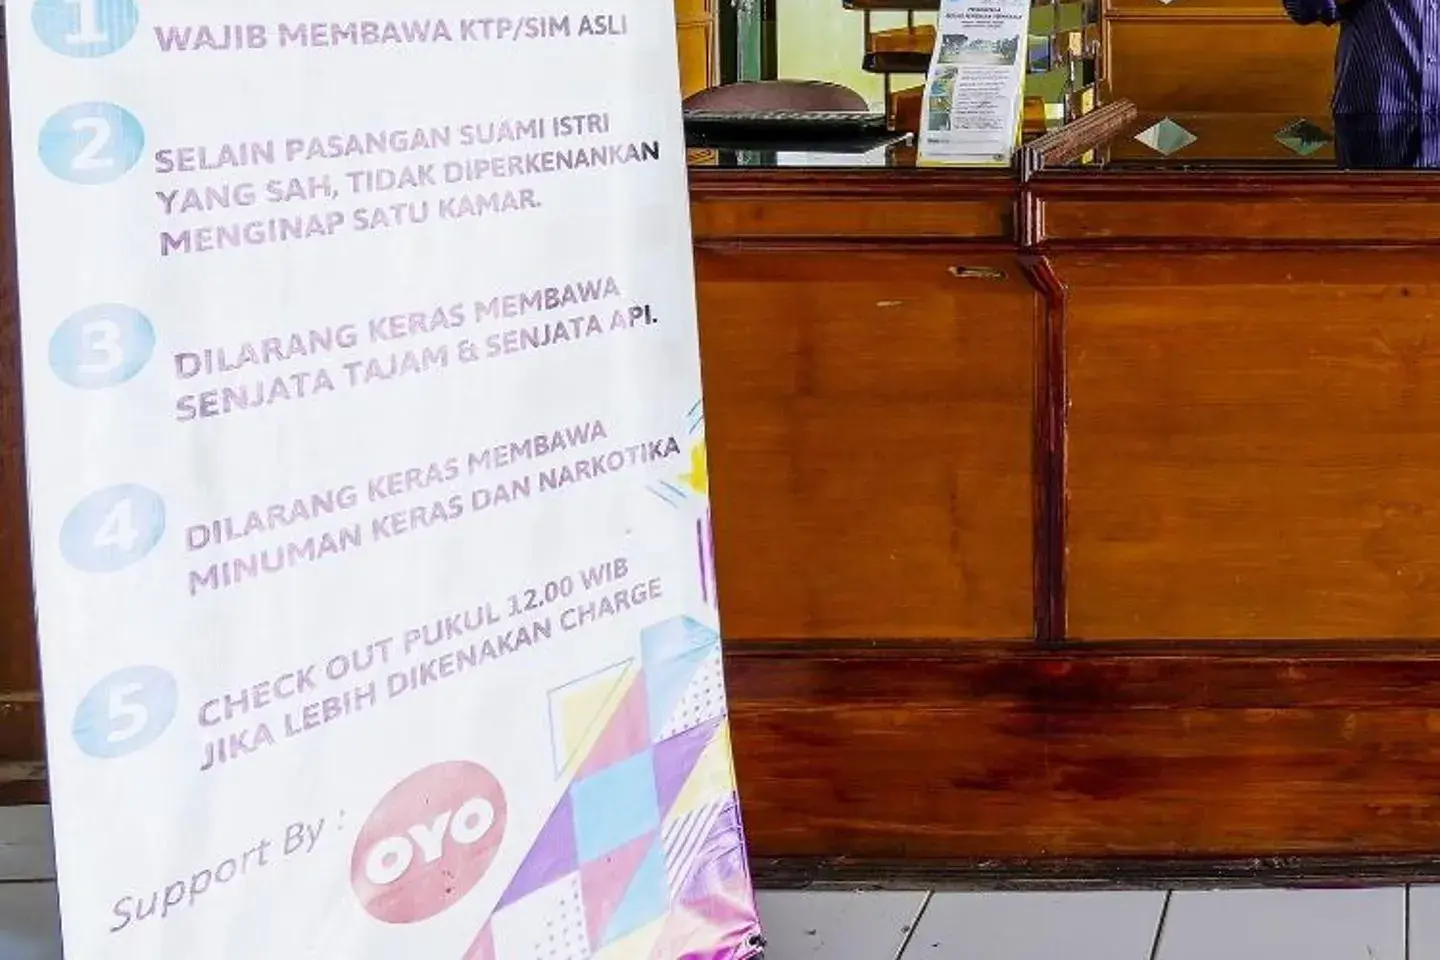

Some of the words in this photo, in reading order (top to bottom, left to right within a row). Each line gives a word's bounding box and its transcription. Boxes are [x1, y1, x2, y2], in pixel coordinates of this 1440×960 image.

[153, 24, 266, 52] WAJIB
[278, 17, 453, 48] MEMBAWA
[460, 15, 571, 43] KTP/SIM
[577, 14, 627, 37] ASLI
[71, 116, 114, 173] 2
[154, 141, 275, 174] SELAIN
[285, 124, 451, 161] PASANGAN
[459, 118, 546, 145] SUAMI
[551, 112, 611, 138] ISTRI
[155, 181, 256, 215] YANG
[266, 171, 338, 204] SAH,
[347, 163, 436, 193] TIDAK
[443, 139, 660, 183] DIPERKENANKAN
[159, 211, 344, 257] MENGINAP
[352, 201, 429, 231] SATU
[438, 187, 542, 220] KAMAR.
[79, 321, 123, 373] 3
[173, 323, 359, 380] DILARANG
[368, 304, 466, 342] KERAS
[473, 276, 621, 323] MEMBAWA
[175, 368, 337, 423] SENJATA
[344, 347, 449, 388] TAJAM
[457, 341, 480, 364] &
[485, 315, 603, 360] SENJATA
[609, 304, 658, 331] API.
[185, 484, 359, 552] DILARANG
[367, 456, 460, 502] KERAS
[467, 418, 608, 473] MEMBAWA
[187, 524, 363, 597] MINUMAN
[371, 492, 465, 544] KERAS
[471, 476, 532, 513] DAN
[538, 435, 682, 492] NARKOTIKA
[93, 502, 139, 552] 4
[198, 663, 316, 731] CHECK
[324, 637, 393, 681] OUT
[403, 603, 502, 656] PUKUL
[507, 574, 575, 616] 12.00
[578, 557, 629, 592] WIB
[201, 723, 277, 772] JIKA
[284, 682, 377, 737] LEBIH
[387, 619, 553, 698] DIKENAKAN
[559, 576, 664, 632] CHARGE
[106, 686, 149, 742] 5
[110, 838, 269, 934] Support
[281, 811, 327, 860] By
[365, 796, 496, 886] OYO
